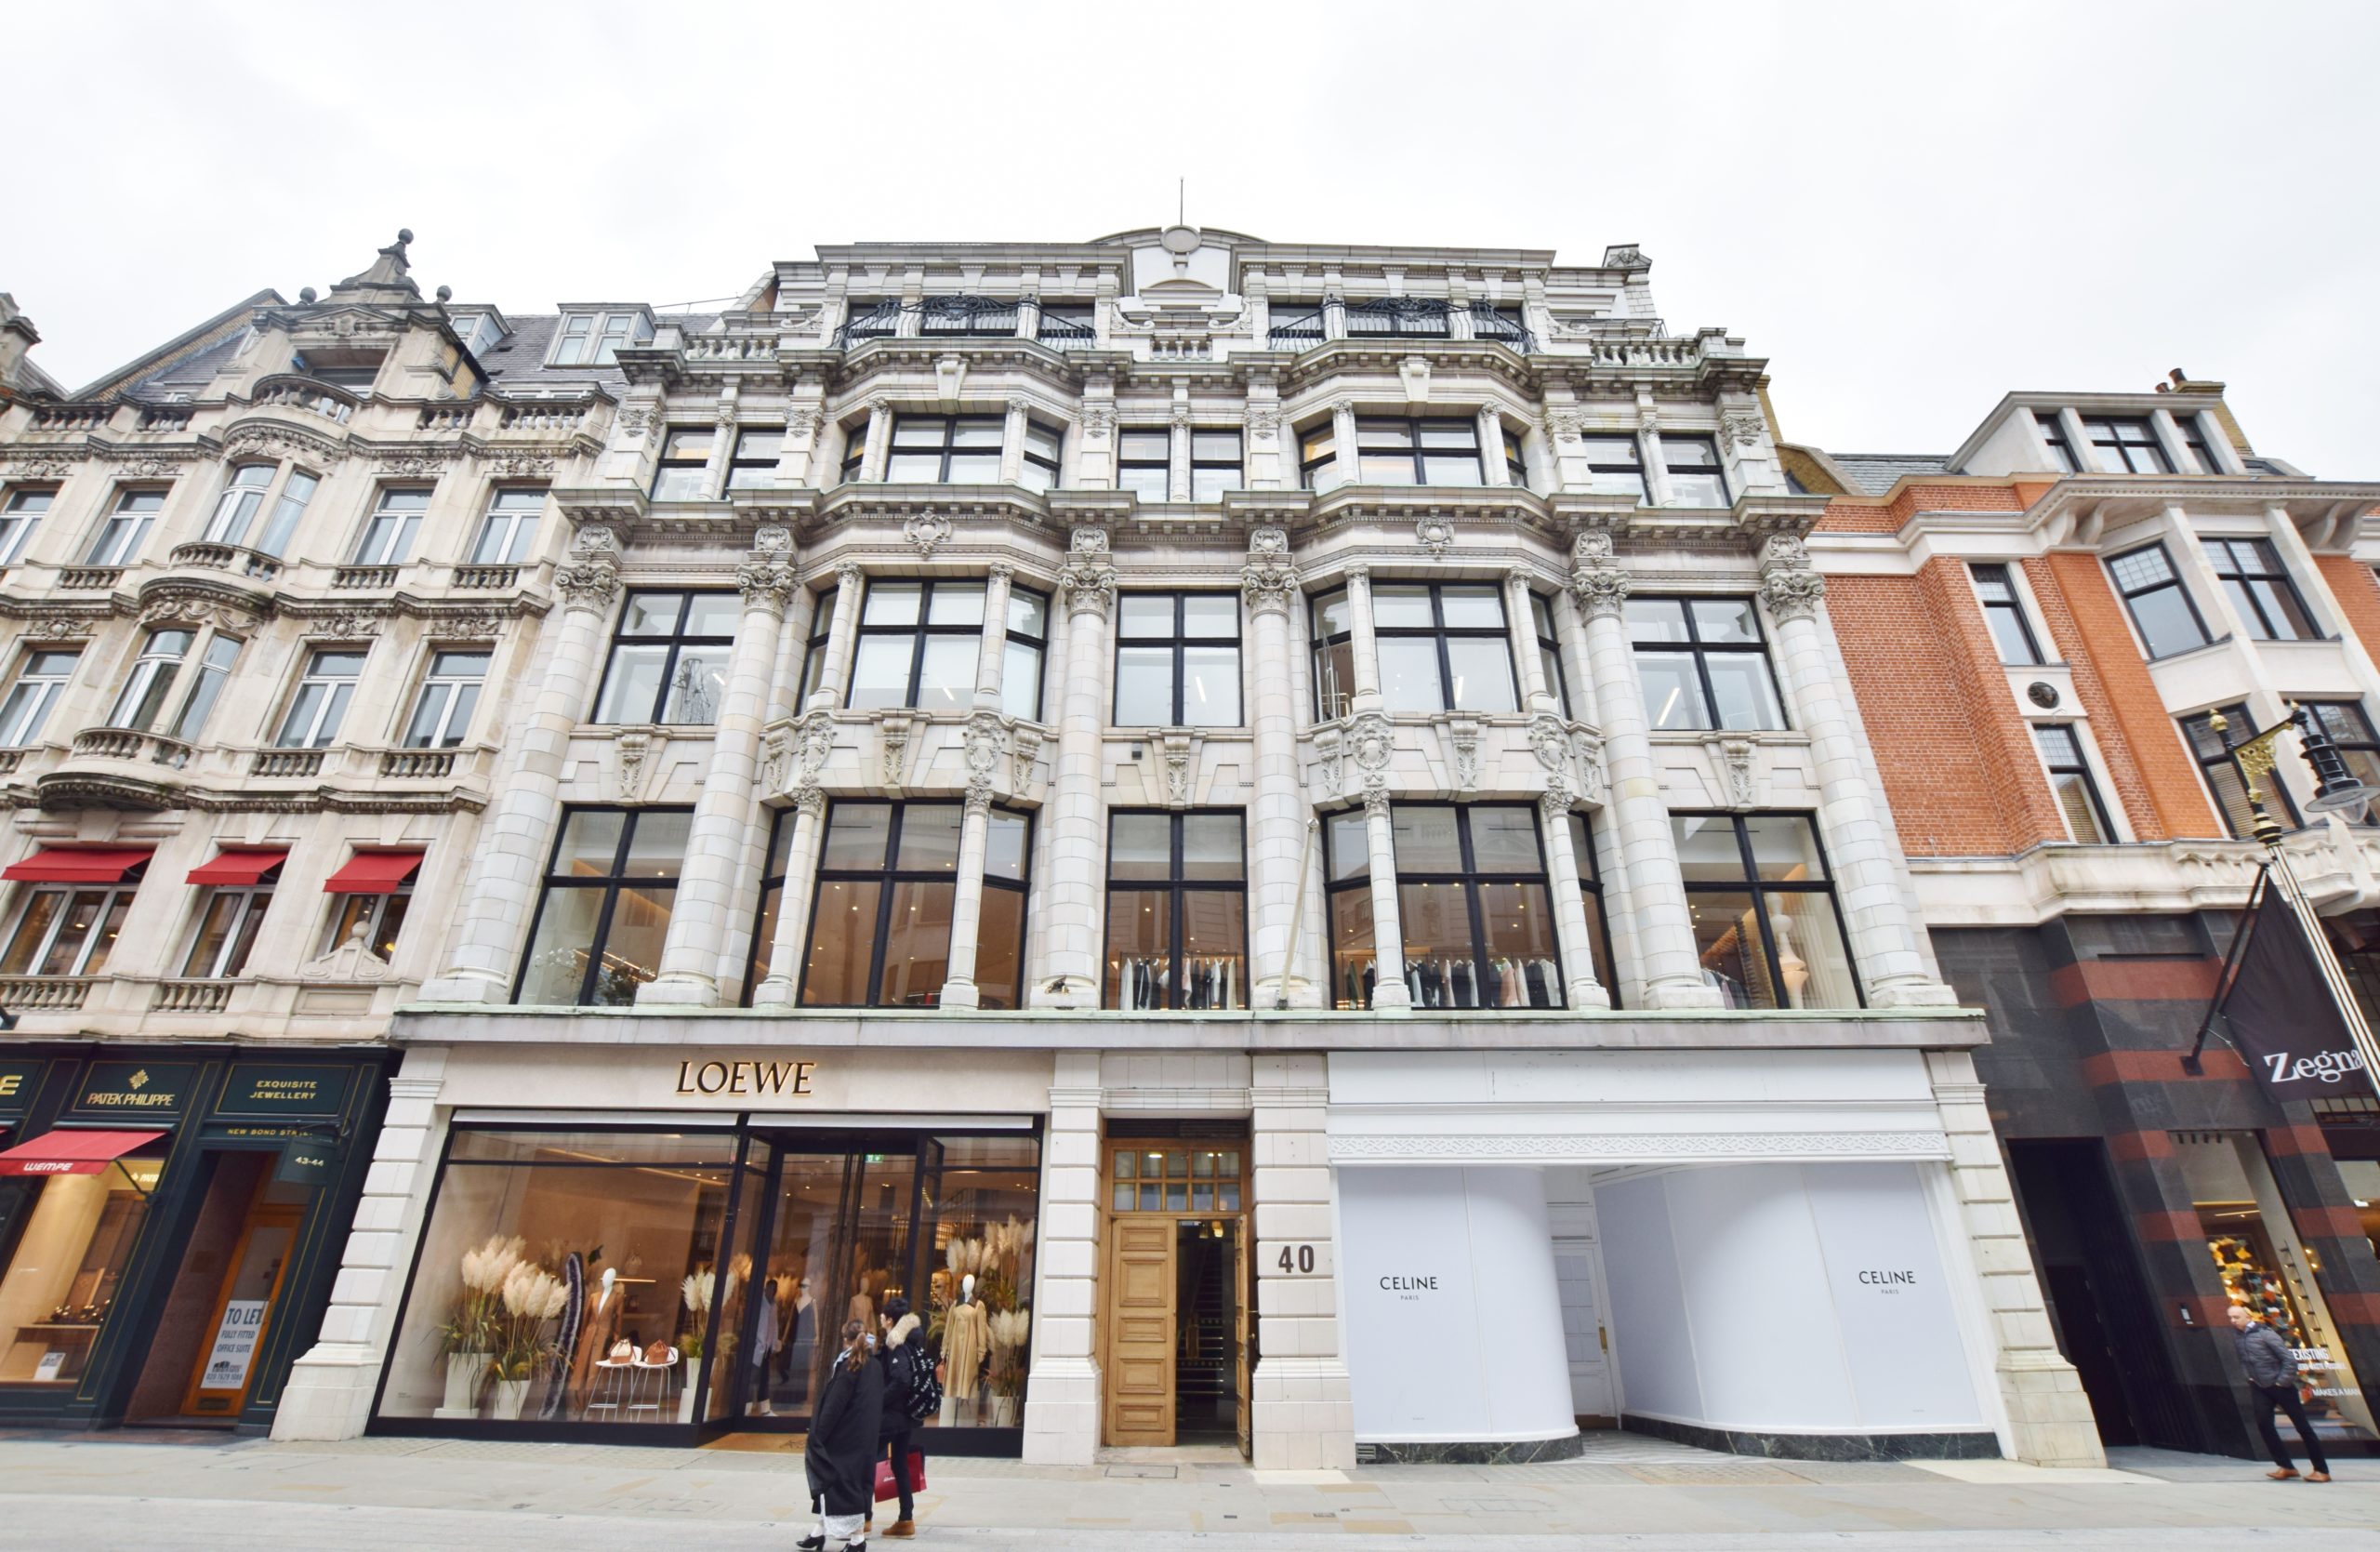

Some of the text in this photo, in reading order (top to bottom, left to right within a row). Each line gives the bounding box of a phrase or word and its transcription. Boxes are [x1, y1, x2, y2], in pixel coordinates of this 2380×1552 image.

[2263, 1049, 2364, 1083] Zegna
[676, 1061, 816, 1094] LOEWE
[256, 1081, 318, 1089] EXQUISITE
[86, 1093, 175, 1106] PATEK PHILIPPE
[23, 1162, 73, 1172] WEMPE
[295, 1156, 324, 1167] 43-44
[1277, 1244, 1315, 1274] 40
[1380, 1276, 1438, 1291] CELINE
[1858, 1270, 1916, 1284] CELINE
[226, 1308, 263, 1325] TO LET
